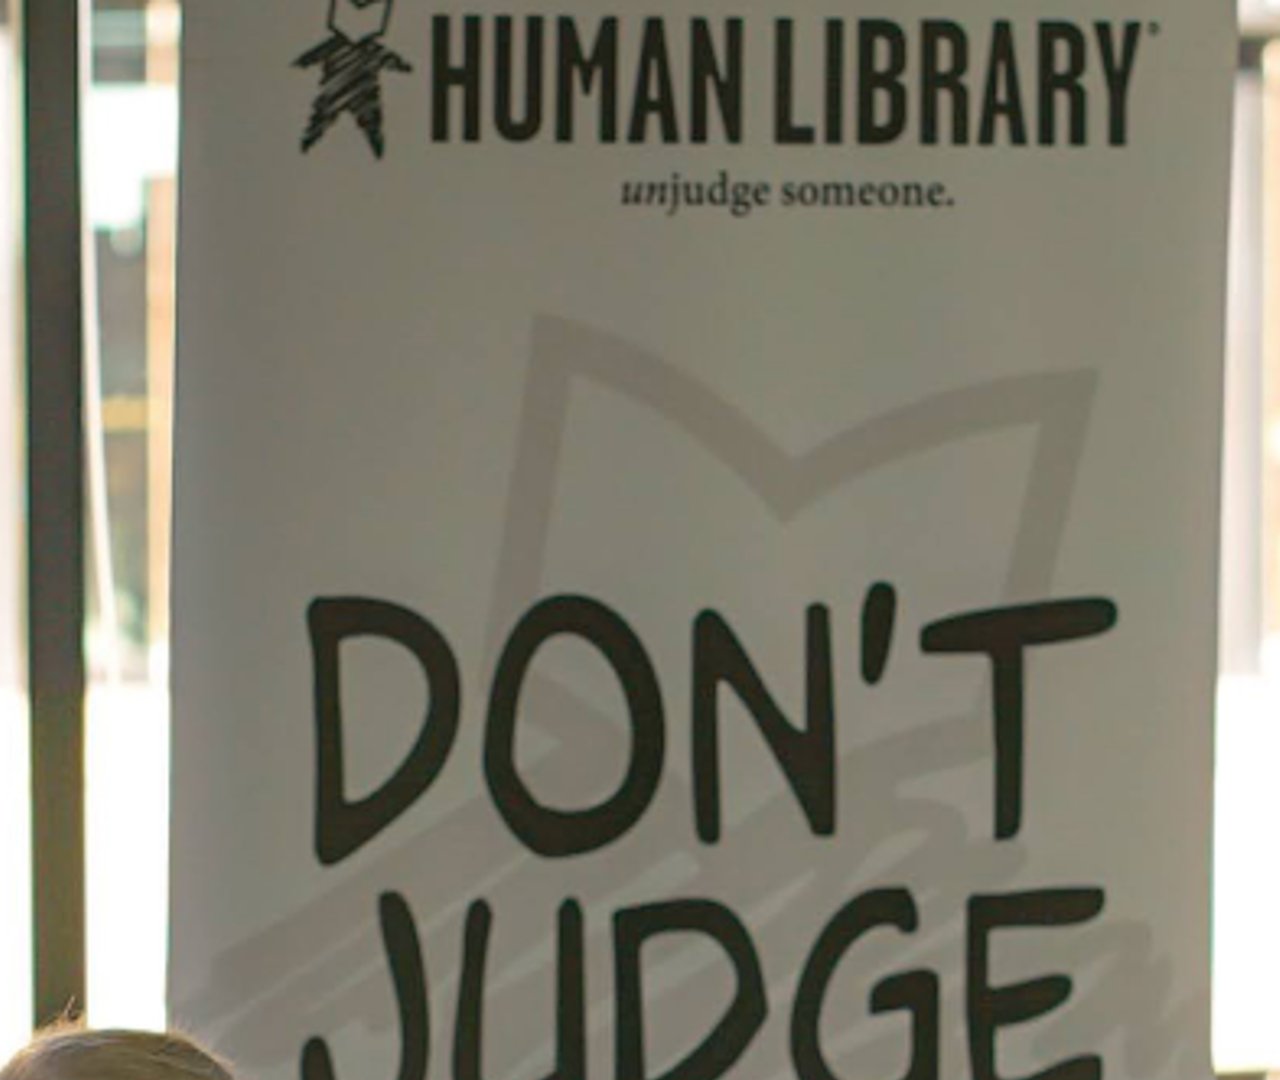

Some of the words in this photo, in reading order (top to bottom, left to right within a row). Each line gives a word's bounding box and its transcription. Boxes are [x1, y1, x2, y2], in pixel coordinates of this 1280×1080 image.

[430, 14, 744, 144] HUMAN
[773, 17, 1142, 147] LIBRARY
[620, 169, 771, 218] unjudge
[781, 180, 956, 208] someone.
[306, 582, 1118, 867] DON'T
